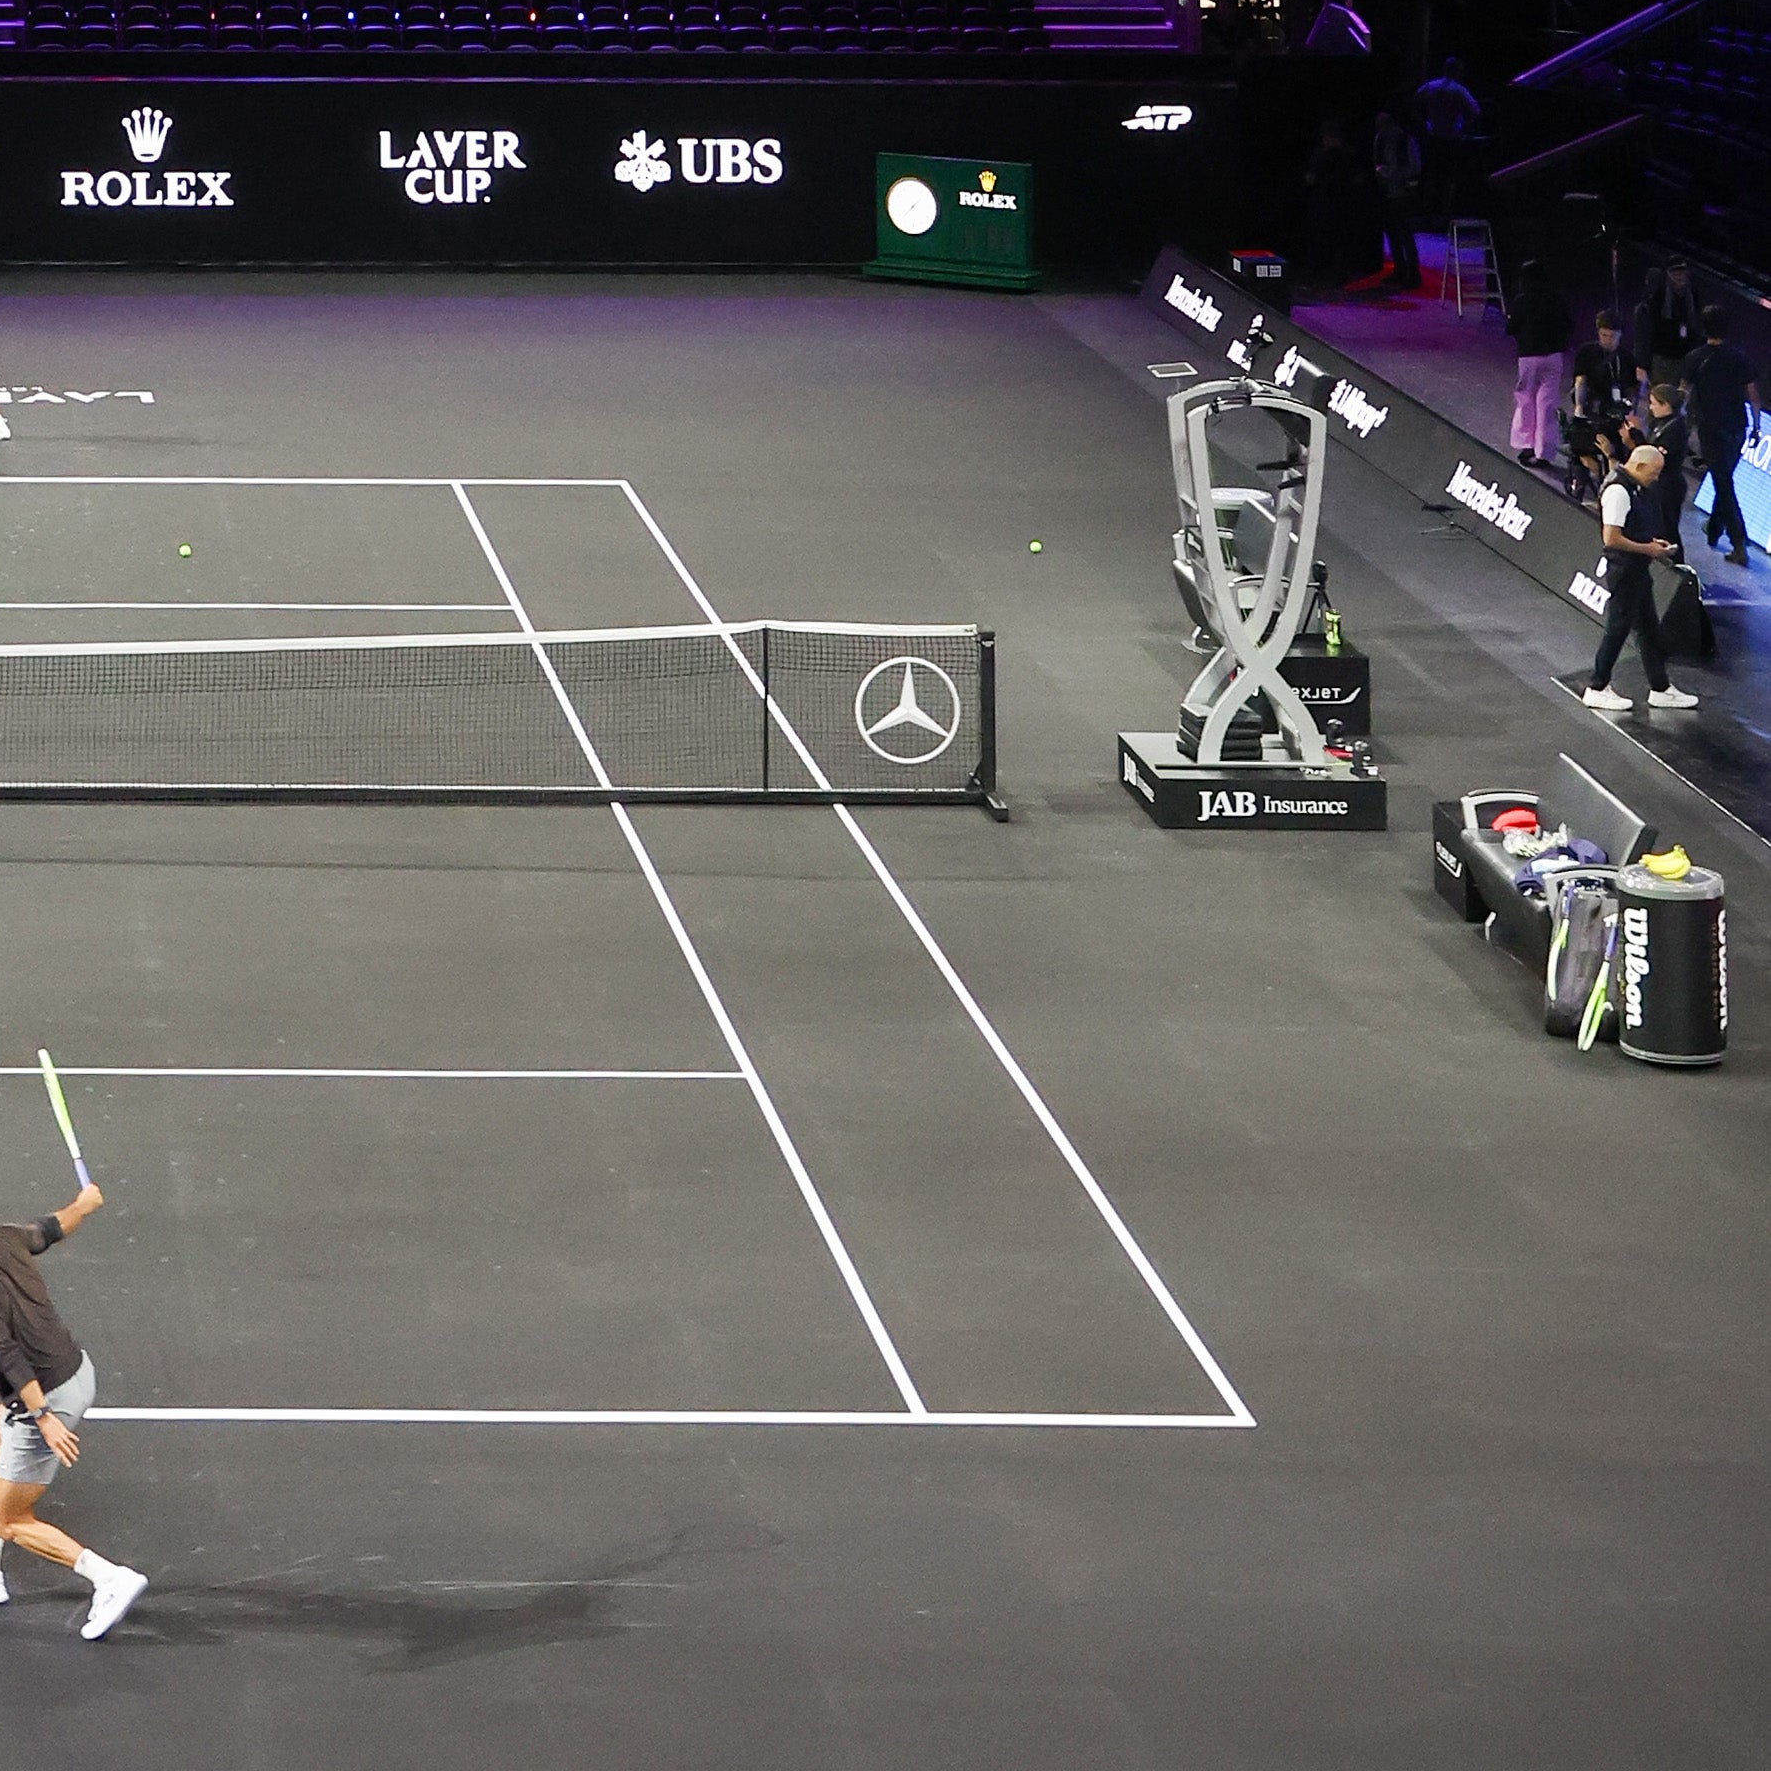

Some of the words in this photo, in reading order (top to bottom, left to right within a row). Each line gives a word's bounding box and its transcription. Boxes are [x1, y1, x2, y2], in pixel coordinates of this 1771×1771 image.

[1121, 105, 1193, 131] ATP
[379, 130, 527, 169] LAVER
[676, 138, 783, 184] UBS
[60, 170, 235, 207] ROLEX
[959, 191, 1017, 210] ROLEX
[1445, 460, 1533, 541] Mercedes-Benz
[1197, 790, 1257, 822] JAB
[1263, 795, 1348, 815] Insurance
[1622, 907, 1651, 1031] Wilson
